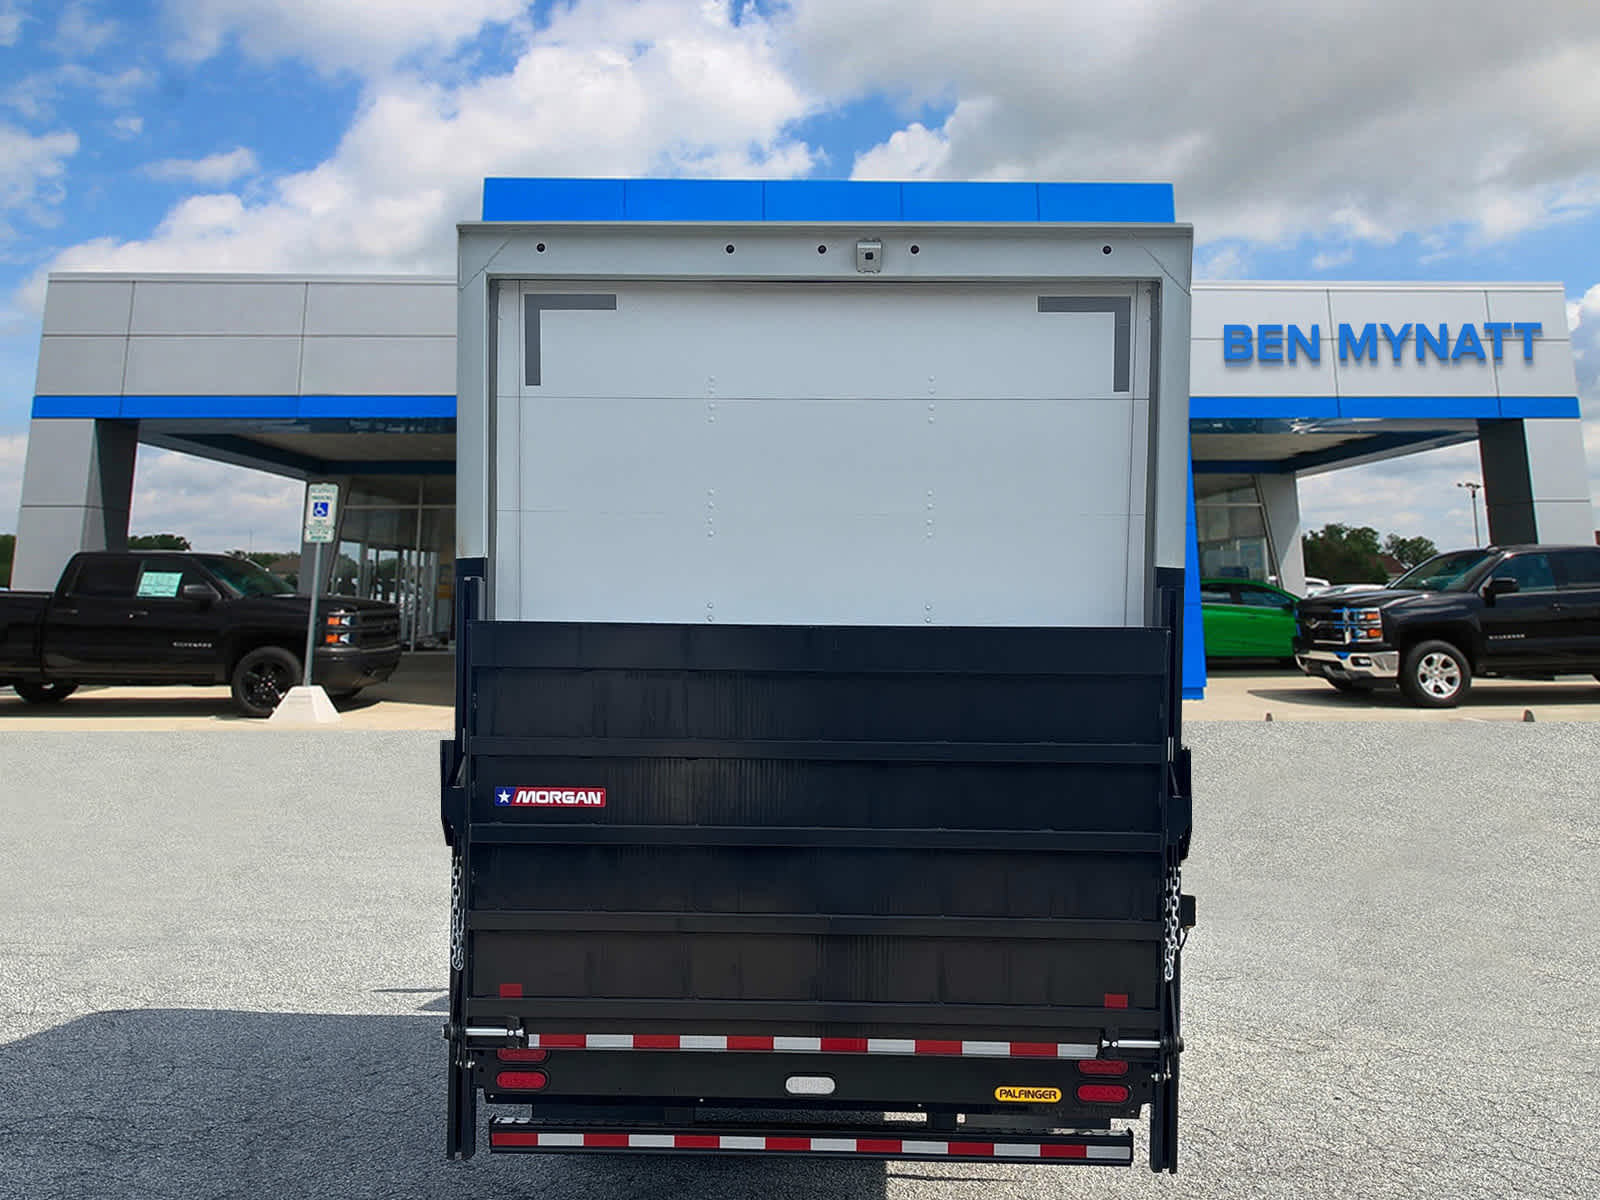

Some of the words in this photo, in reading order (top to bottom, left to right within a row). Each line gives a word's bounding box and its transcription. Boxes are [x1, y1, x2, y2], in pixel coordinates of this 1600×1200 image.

[1223, 324, 1321, 365] BEN
[1338, 322, 1543, 365] MYNATT
[515, 790, 602, 805] MORGAN
[999, 1088, 1057, 1100] PALFINGER
